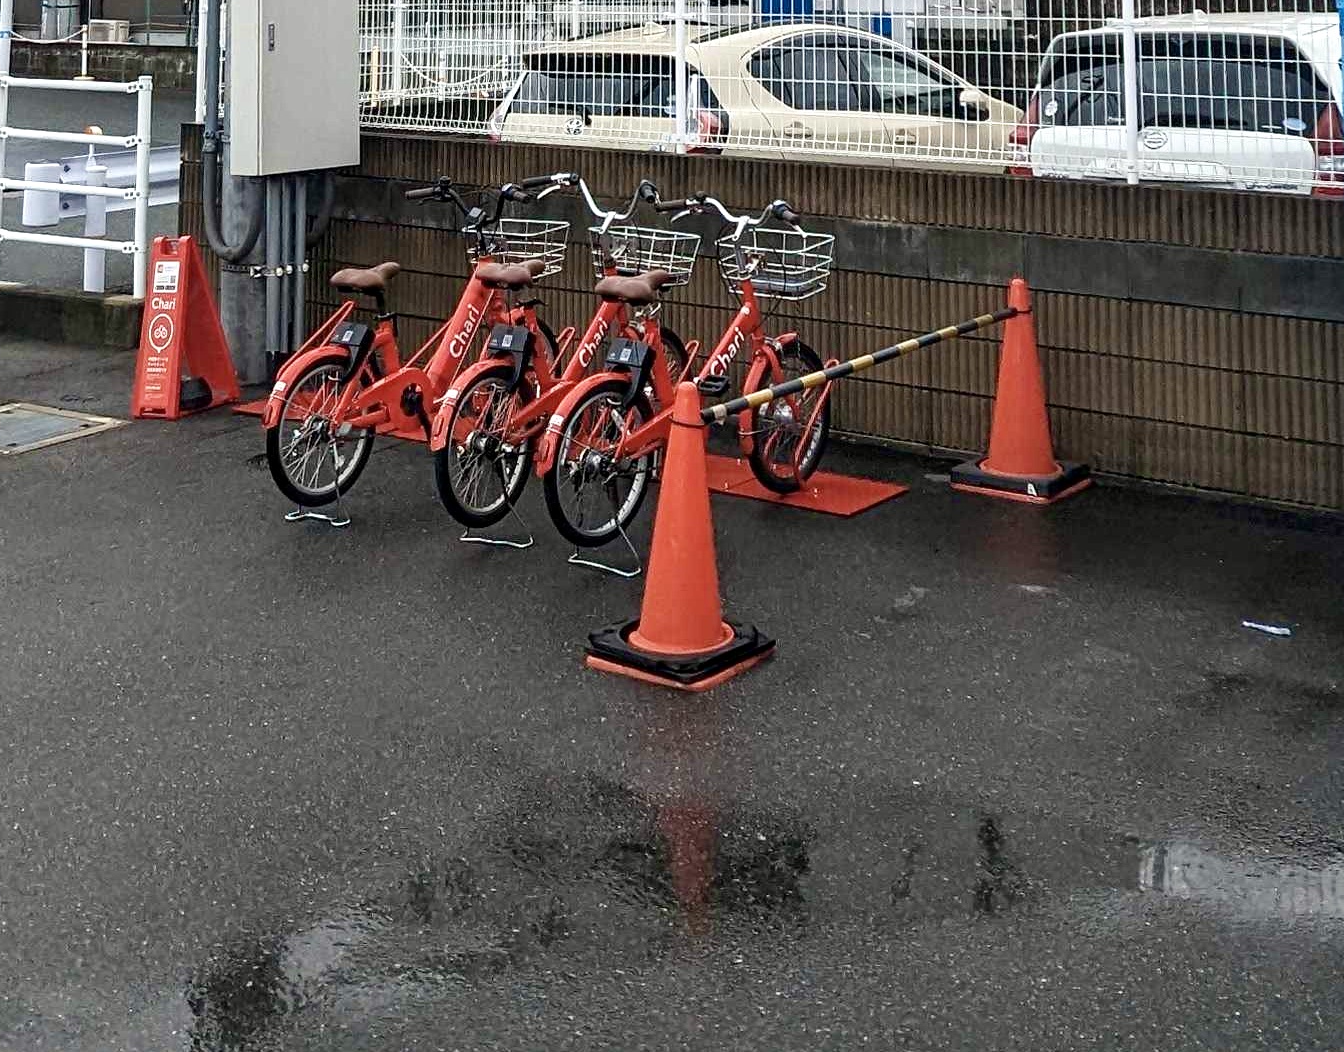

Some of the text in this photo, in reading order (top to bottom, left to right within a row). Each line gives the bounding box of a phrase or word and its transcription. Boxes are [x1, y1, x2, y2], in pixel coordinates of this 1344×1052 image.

[151, 297, 176, 310] Chari
[449, 303, 480, 359] Chari
[578, 316, 609, 368] Chari
[710, 326, 745, 377] Chari
